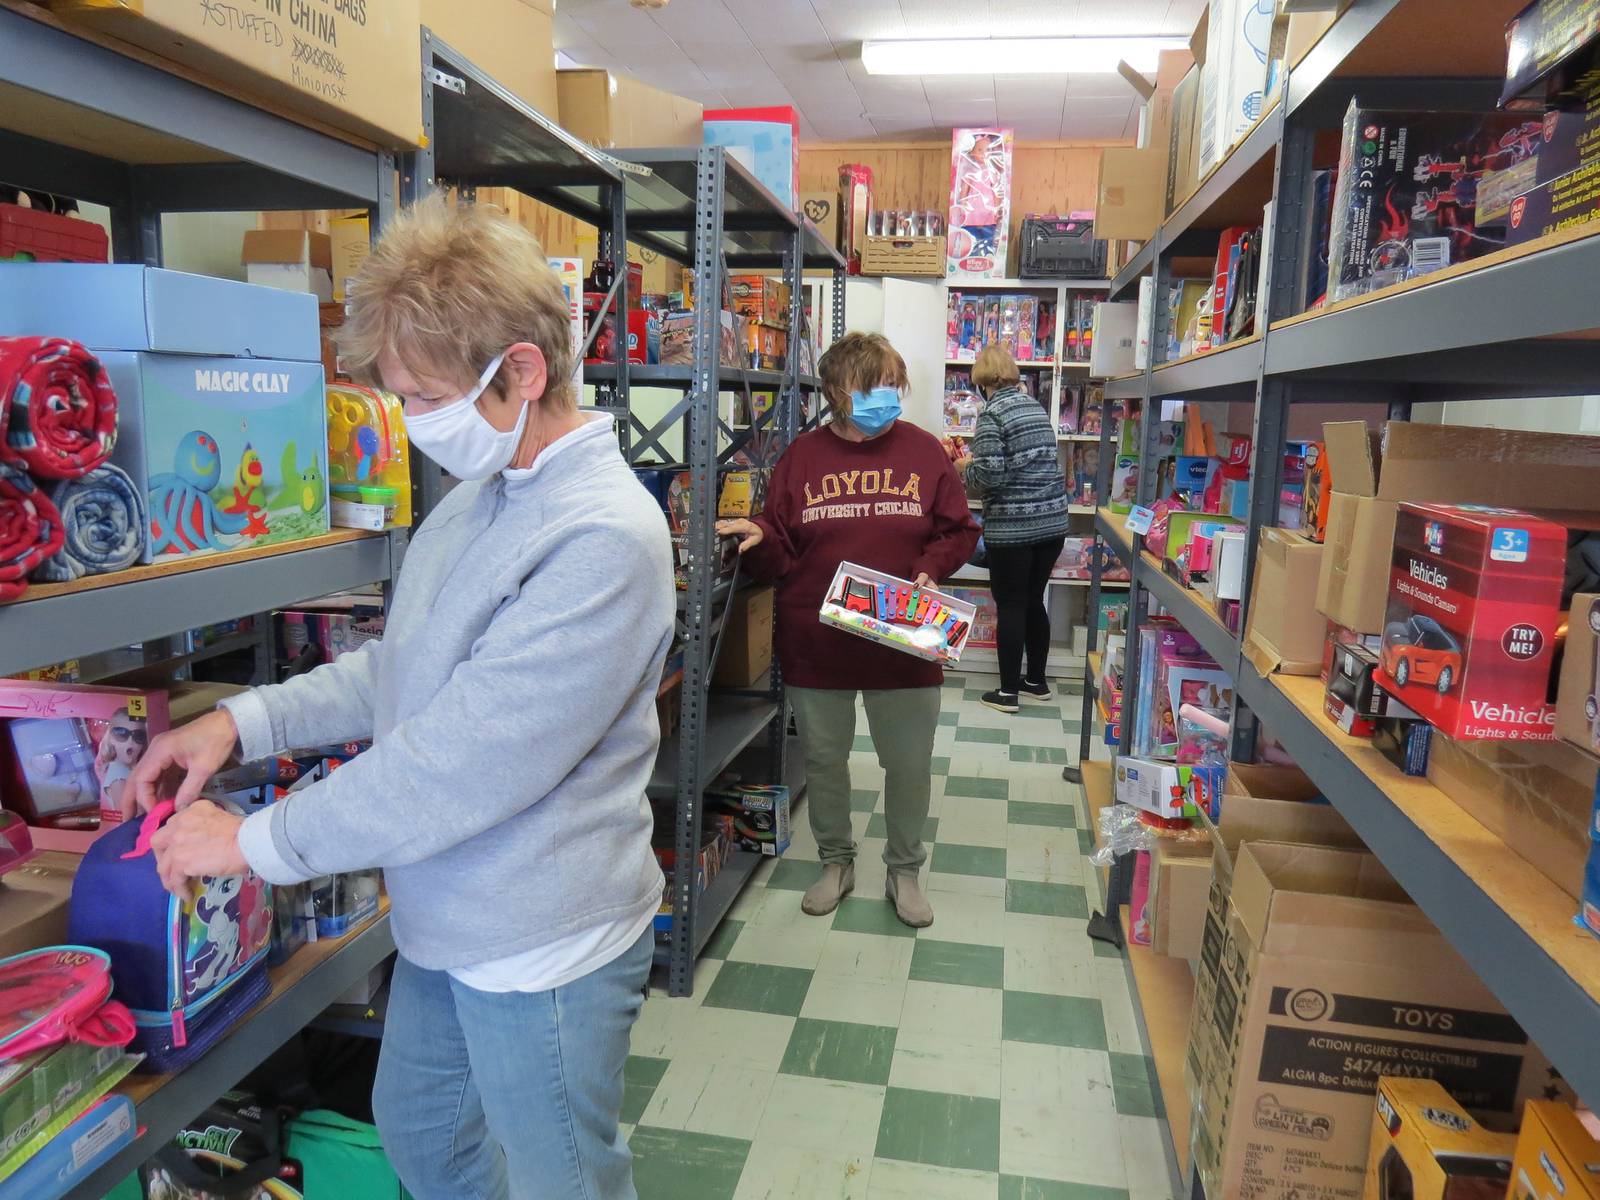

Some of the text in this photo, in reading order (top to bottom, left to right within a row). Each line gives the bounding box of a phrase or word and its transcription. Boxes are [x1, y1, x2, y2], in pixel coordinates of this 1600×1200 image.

[195, 369, 290, 393] MAGIC CLAY
[803, 469, 921, 506] LOYOLA
[802, 503, 871, 523] UNIVERSITY
[1501, 531, 1524, 550] 3+
[1409, 559, 1448, 590] Vehicles
[1396, 579, 1410, 594] Lights
[1414, 588, 1434, 605] Sounds
[1434, 596, 1457, 614] Camaro
[1511, 628, 1537, 641] TRY
[1509, 641, 1533, 654] ME!
[1464, 725, 1506, 739] Lights
[1508, 729, 1519, 739] &
[344, 743, 358, 752] 2.0
[279, 768, 298, 777] 2.0
[1392, 1007, 1454, 1030] TOYS
[1308, 1036, 1478, 1067] ACTION FIGURES COLLECTIBLES
[1282, 1066, 1316, 1082] ALGM
[1318, 1073, 1339, 1086] 8pc
[1273, 1112, 1308, 1125] LITTLE
[1378, 1093, 1394, 1127] CAT
